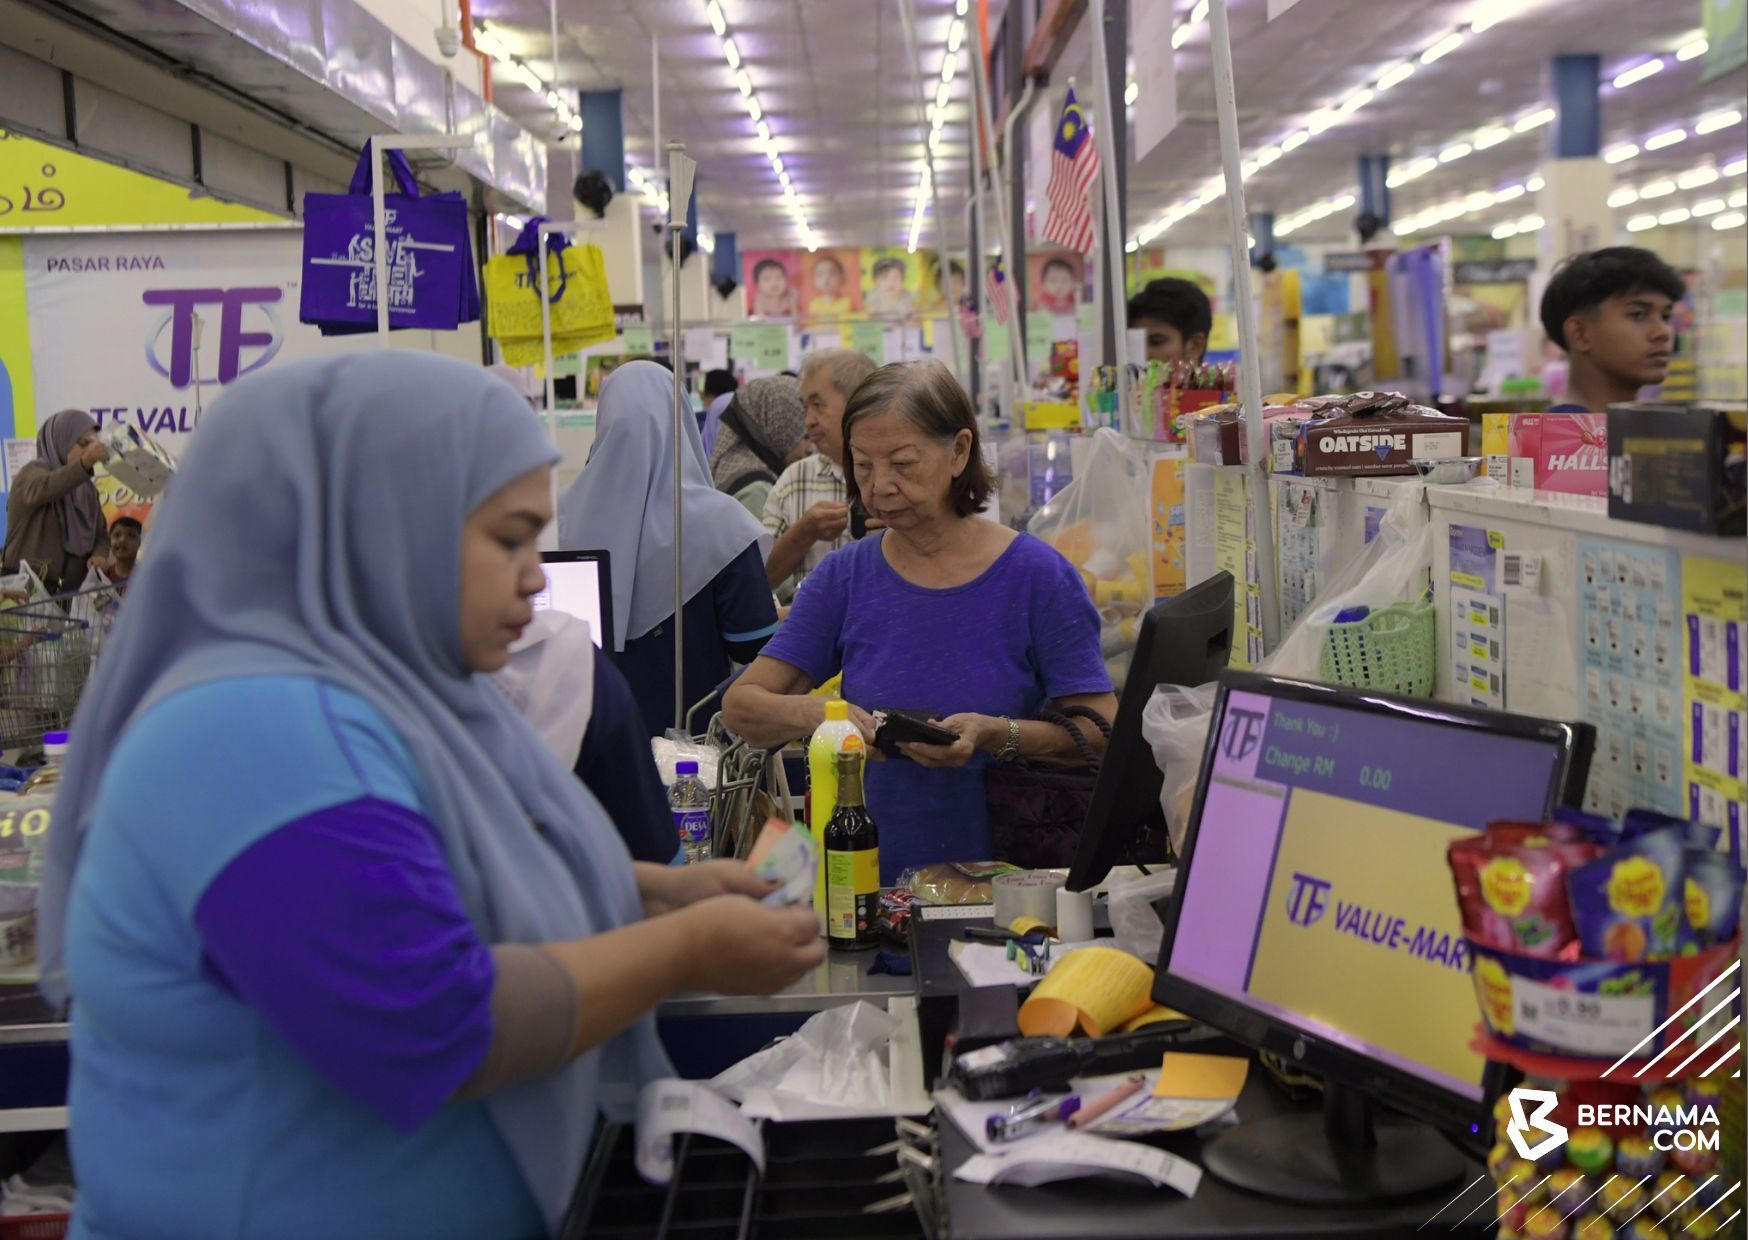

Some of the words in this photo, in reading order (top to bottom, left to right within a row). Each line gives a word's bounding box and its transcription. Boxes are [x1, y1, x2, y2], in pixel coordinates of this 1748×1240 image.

[47, 257, 110, 273] PASAR
[116, 256, 165, 271] RAYA
[142, 286, 283, 389] TF
[1319, 434, 1406, 454] OATSIDE
[1274, 712, 1303, 733] Thank
[1306, 718, 1327, 738] You
[1264, 745, 1311, 774] Change
[1313, 755, 1335, 777] RM
[1359, 765, 1393, 791] 0.00
[1287, 872, 1332, 927] TF
